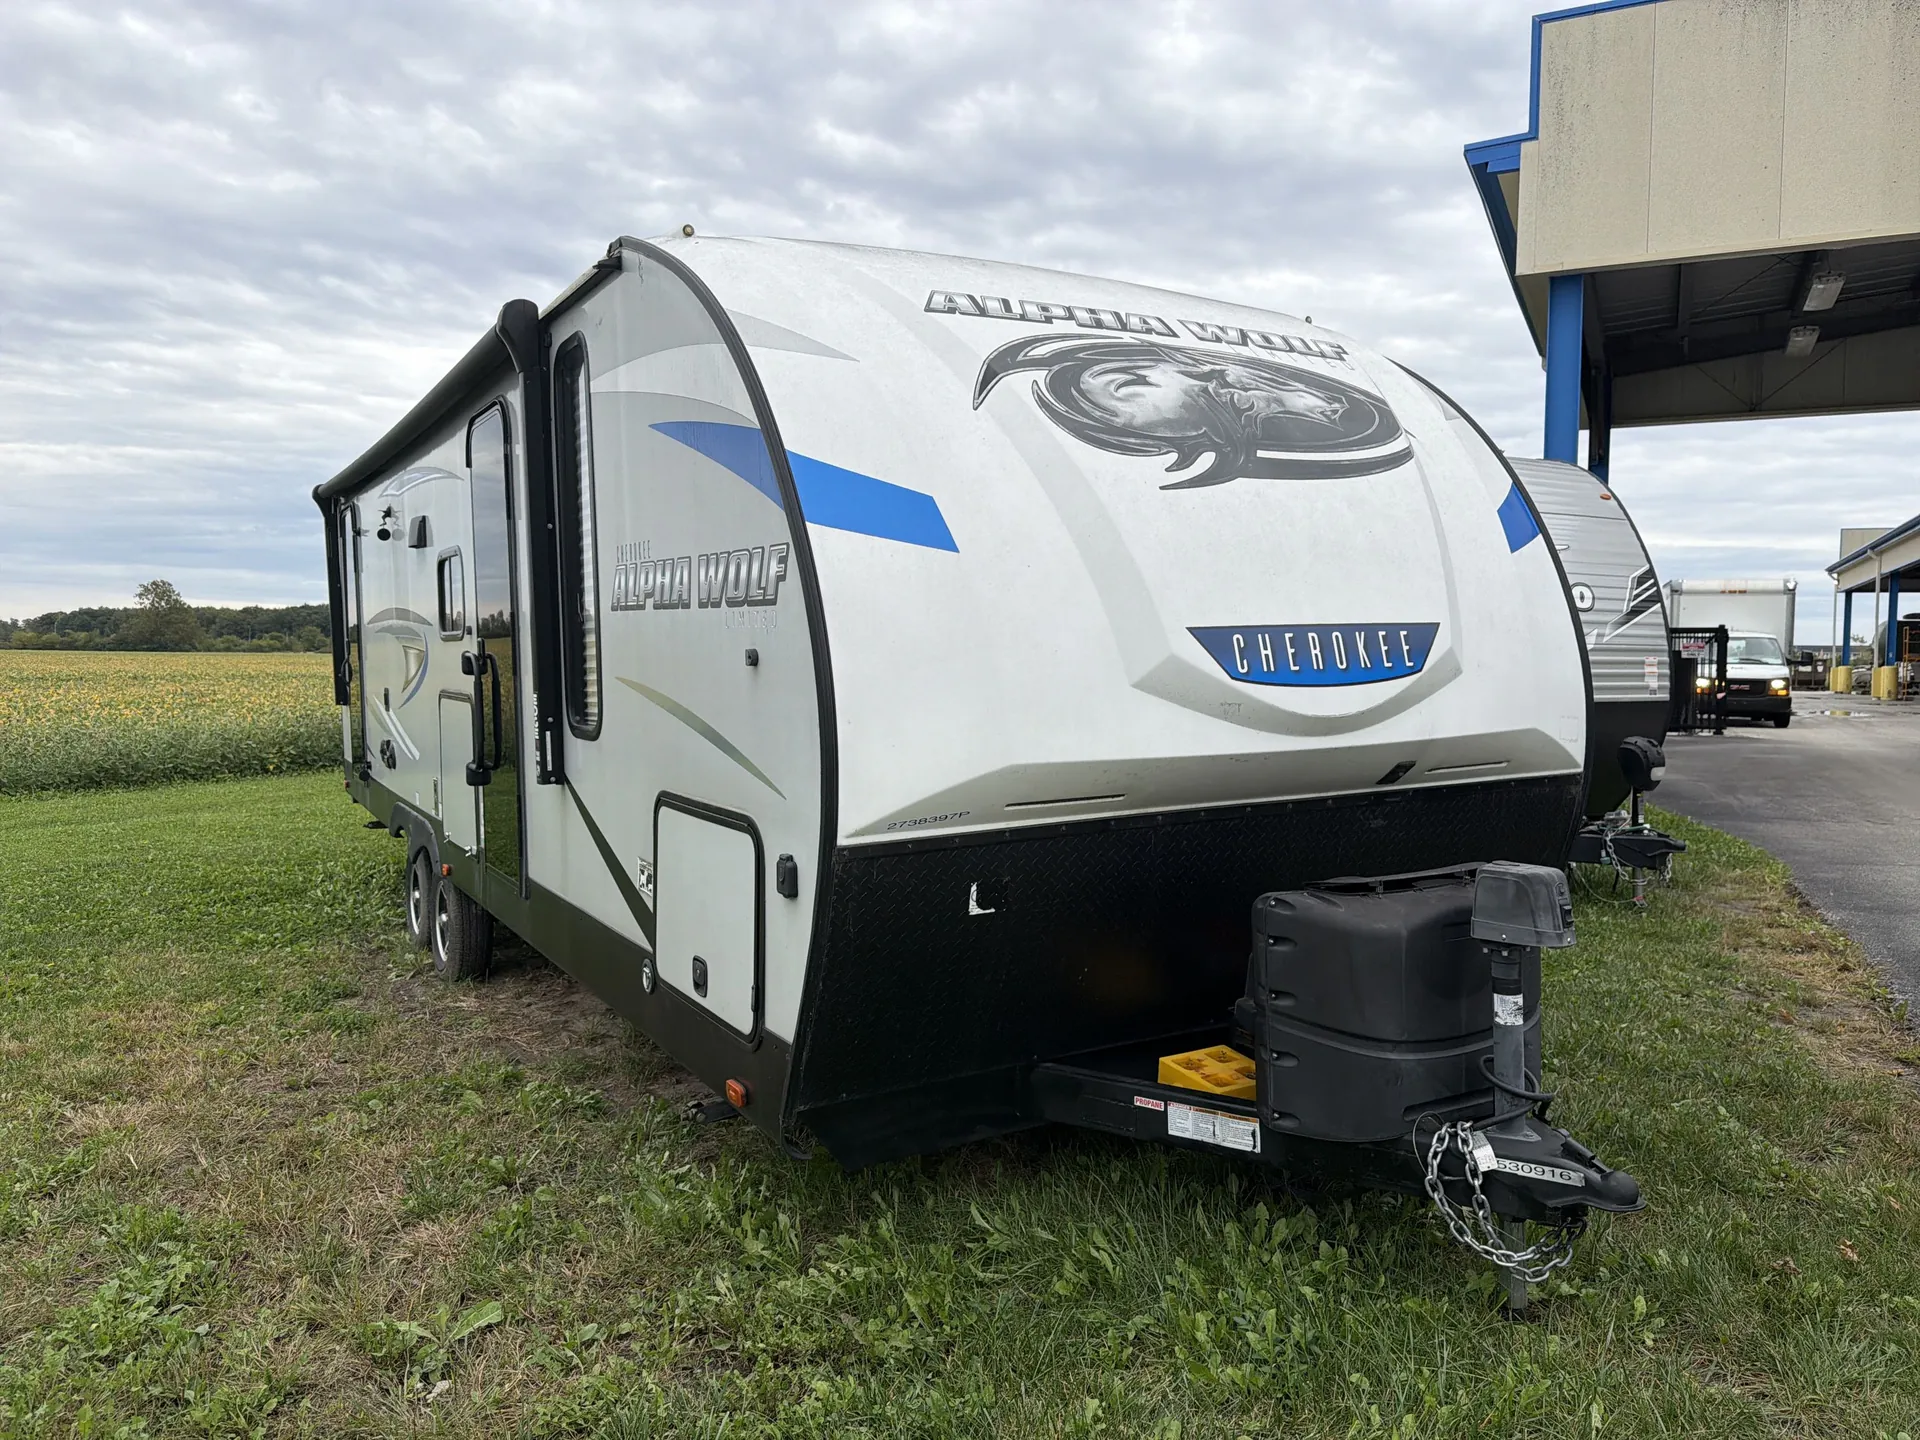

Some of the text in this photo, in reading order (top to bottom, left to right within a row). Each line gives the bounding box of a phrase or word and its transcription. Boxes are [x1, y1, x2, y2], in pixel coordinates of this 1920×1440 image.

[924, 289, 1349, 361] ALPHA WOLF
[611, 542, 789, 611] ALPHA WOLF
[1231, 630, 1415, 673] CHEROKEE
[887, 810, 970, 830] 2738397P
[1135, 1096, 1163, 1110] PROPANE
[1497, 1159, 1573, 1181] 530916
